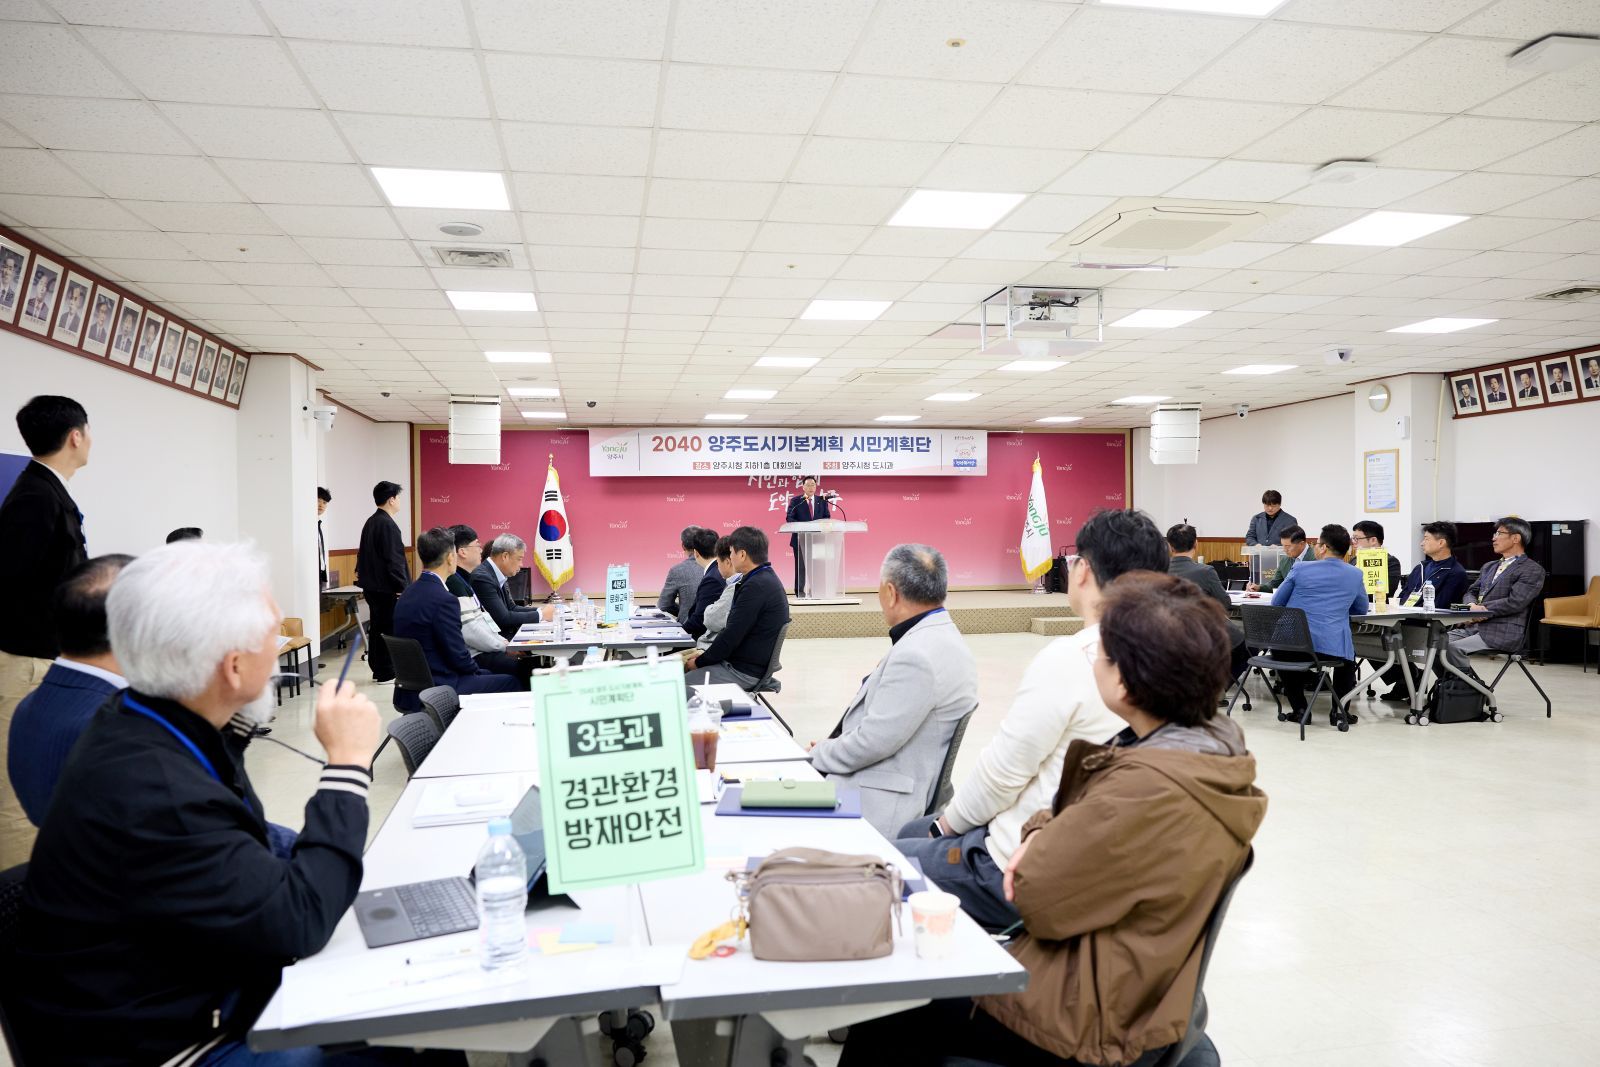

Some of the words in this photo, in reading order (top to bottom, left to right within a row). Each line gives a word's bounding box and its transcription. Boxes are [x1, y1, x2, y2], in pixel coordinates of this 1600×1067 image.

[652, 435, 702, 452] 2040
[708, 435, 844, 453] 양주도시기본계획
[849, 435, 932, 453] 시민계획단
[713, 462, 742, 470] 양주시청
[745, 462, 770, 470] 지하1층
[773, 462, 802, 470] 대회의실
[842, 461, 870, 470] 양주시청
[873, 461, 894, 470] 도시과
[1367, 570, 1380, 578] 도시
[577, 715, 654, 752] 3분과
[560, 767, 679, 810] 경관환경
[564, 806, 683, 850] 방재안전
